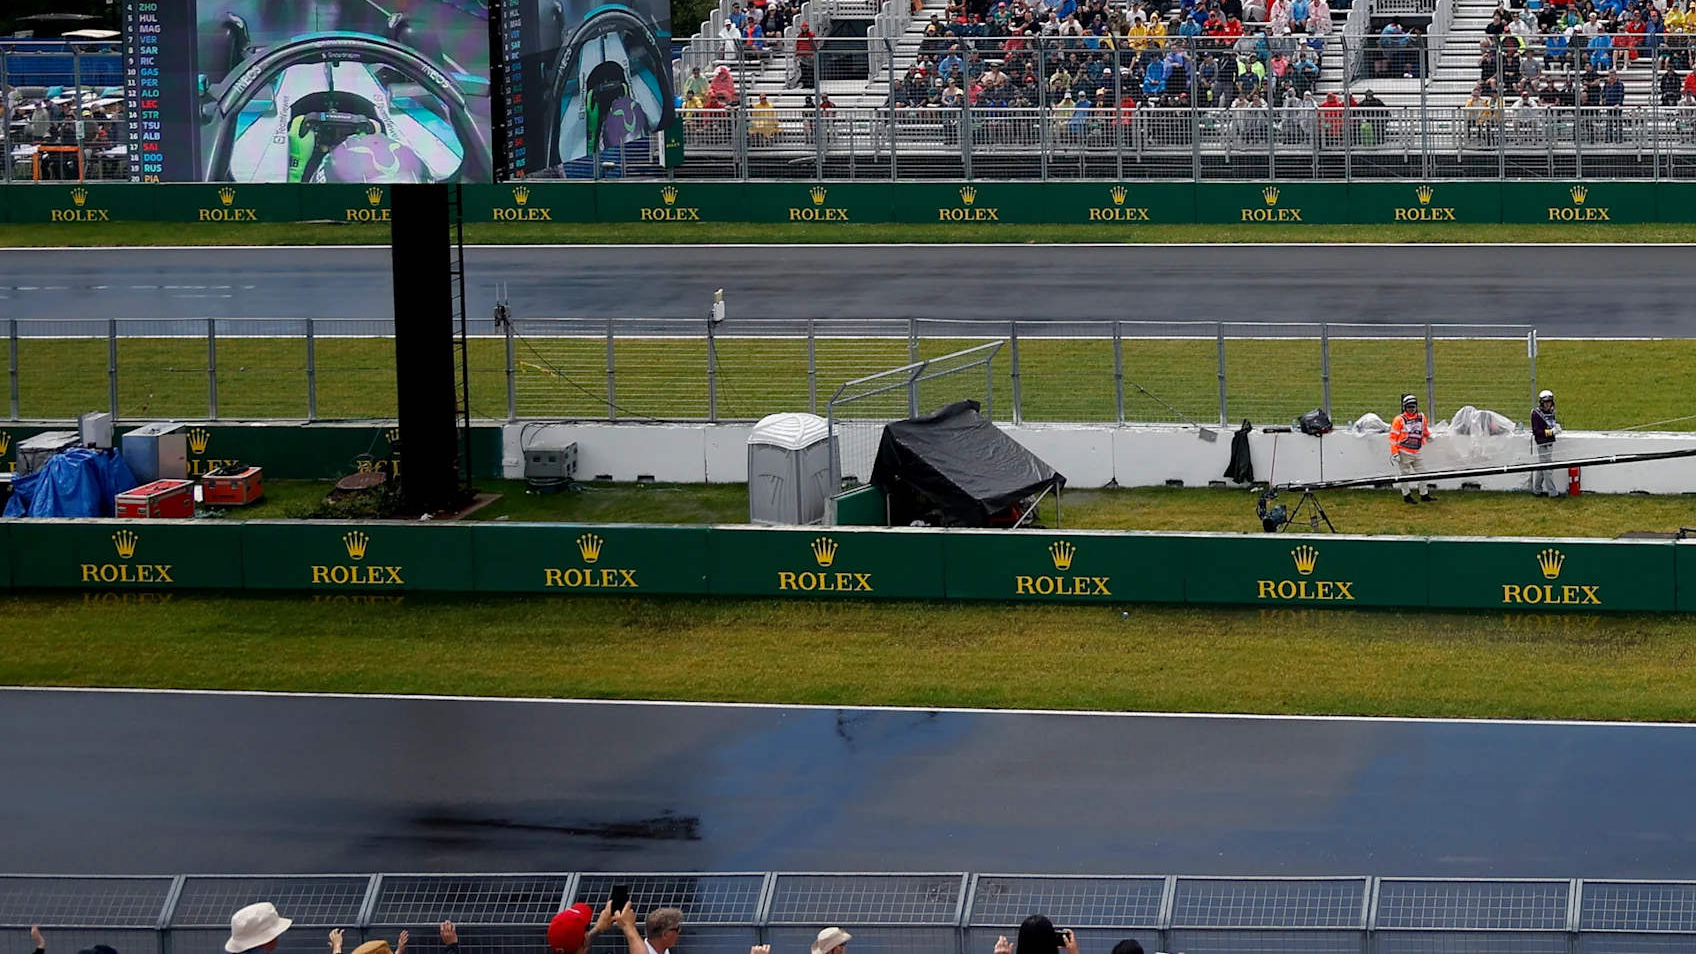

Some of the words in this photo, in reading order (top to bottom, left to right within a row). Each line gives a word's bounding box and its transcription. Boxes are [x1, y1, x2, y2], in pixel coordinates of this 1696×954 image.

[140, 14, 157, 22] HUL
[140, 25, 160, 33] MAG
[140, 36, 157, 44] VER
[140, 46, 158, 54] SAR
[140, 57, 154, 65] RIC
[141, 68, 159, 76] GAS
[233, 64, 262, 94] INEOS
[421, 64, 450, 89] INEOS
[141, 79, 158, 87] PER
[142, 100, 158, 108] LEC
[142, 111, 159, 119] STR
[142, 122, 160, 130] TSU
[143, 132, 160, 140] ALB
[143, 143, 158, 151] SAI
[144, 154, 163, 162] DOO
[144, 164, 162, 172] RUS
[51, 208, 108, 222] ROLEX
[199, 208, 257, 222] ROLEX
[346, 208, 392, 222] ROLE
[493, 208, 551, 222] ROLEX
[641, 208, 699, 222] ROLEX
[790, 208, 848, 222] ROLEX
[939, 208, 998, 222] ROLEX
[1090, 208, 1149, 222] ROLEX
[1242, 208, 1301, 222] ROLEX
[1395, 208, 1455, 222] ROLEX
[1549, 207, 1609, 222] ROLEX
[81, 563, 174, 584] ROLEX
[311, 564, 404, 585] ROLEX
[545, 567, 639, 589] ROLEX
[778, 570, 873, 592] ROLEX
[1016, 574, 1112, 596] ROLEX
[1257, 580, 1355, 601] ROLEX
[1502, 583, 1602, 606] ROLEX
